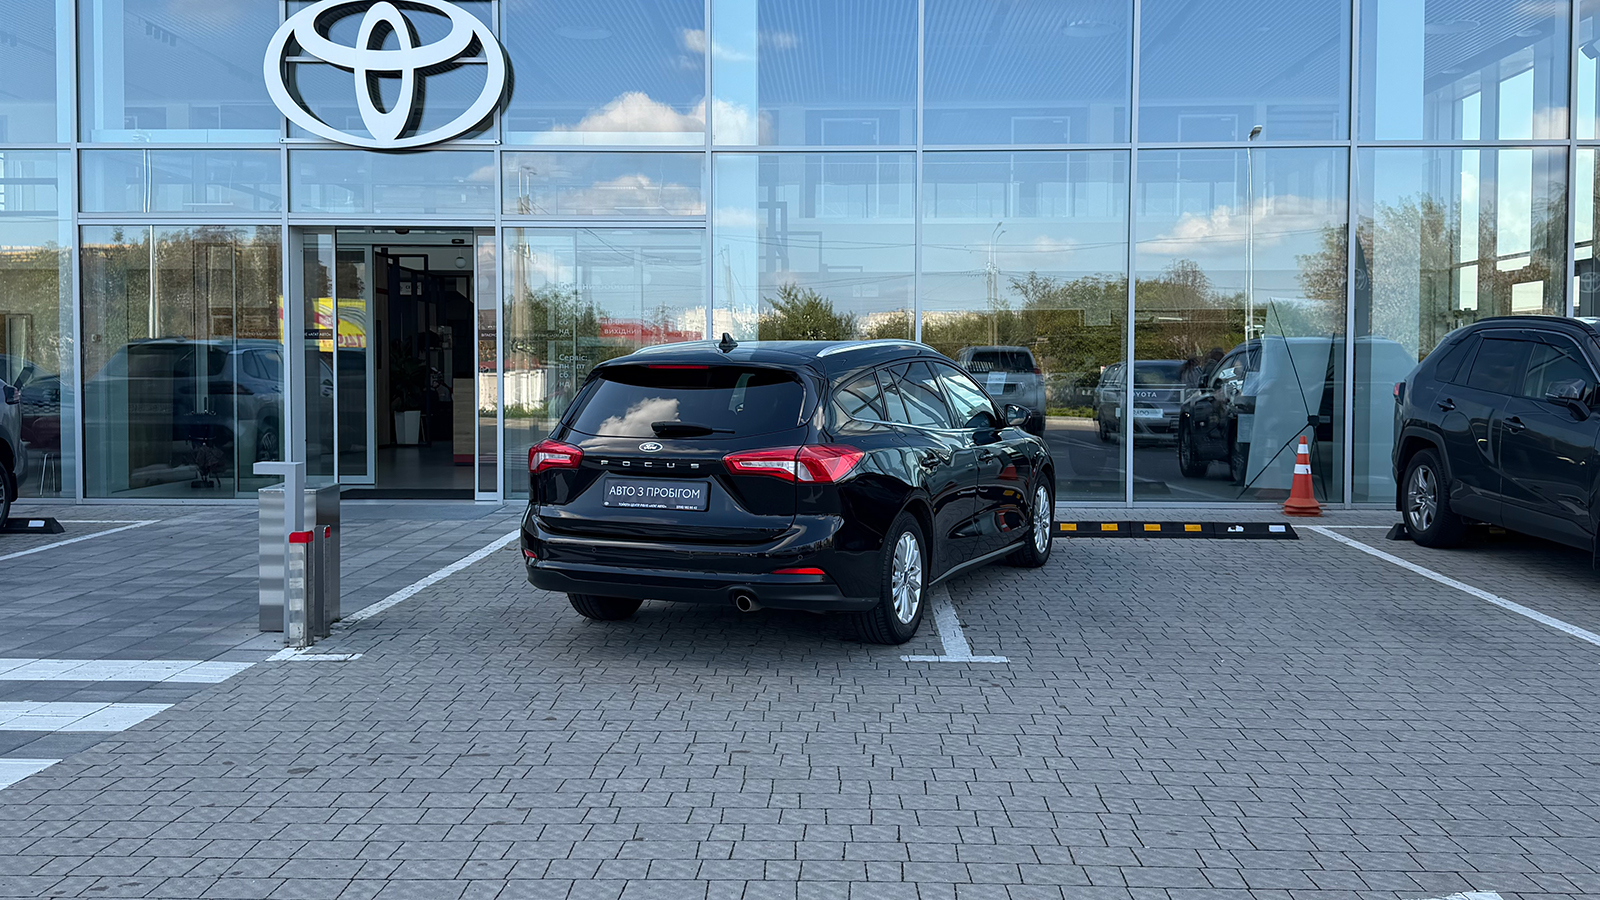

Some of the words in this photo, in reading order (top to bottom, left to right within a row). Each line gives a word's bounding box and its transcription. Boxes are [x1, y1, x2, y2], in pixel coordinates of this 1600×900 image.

[601, 460, 699, 469] FOCUS
[609, 486, 636, 497] АВТО
[646, 487, 700, 499] ПРОБІГОМ
